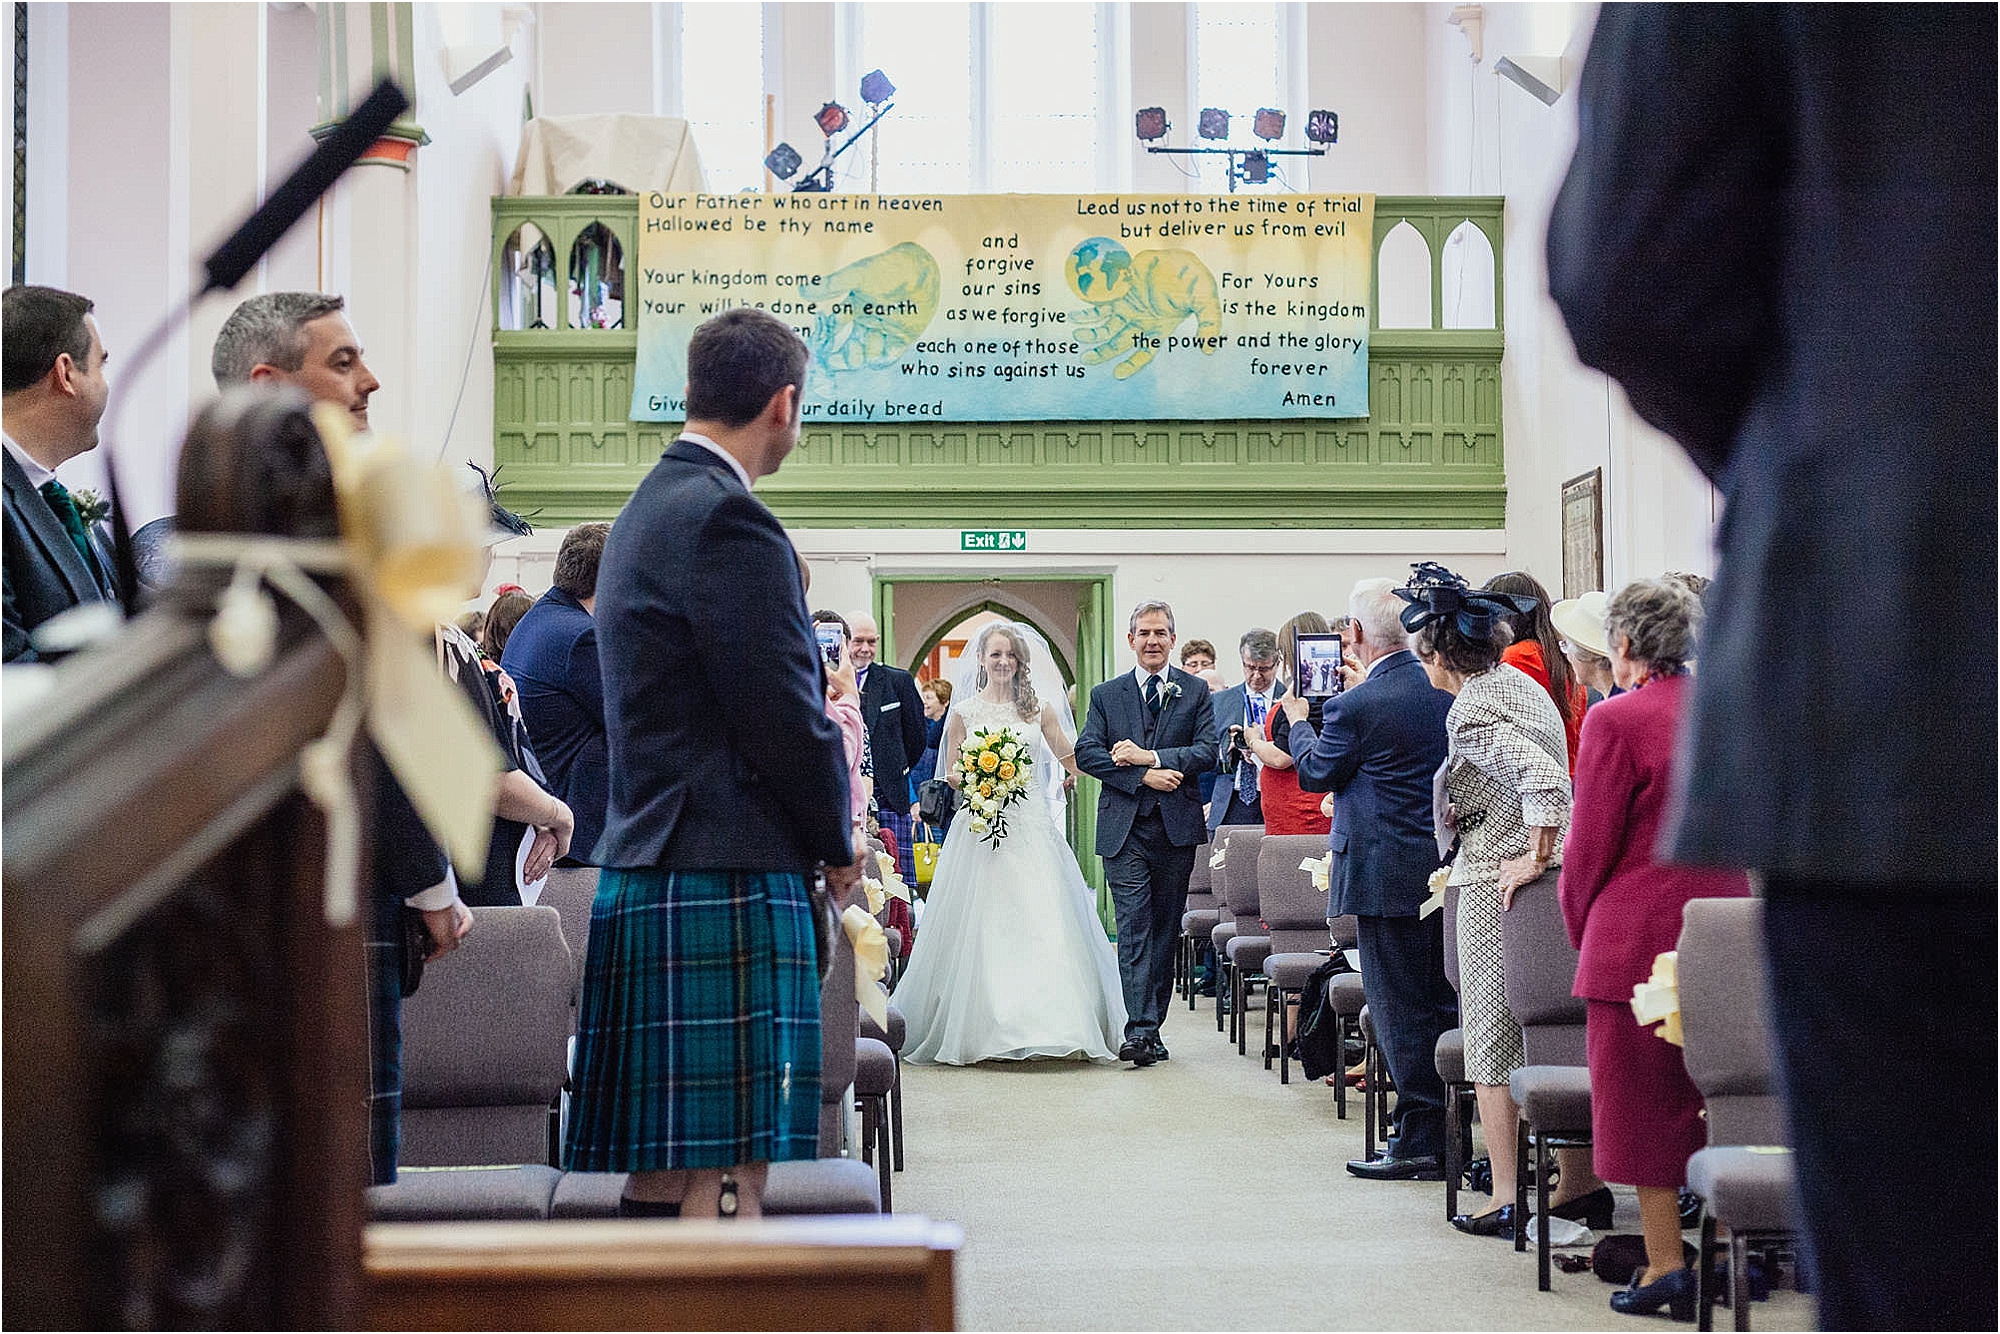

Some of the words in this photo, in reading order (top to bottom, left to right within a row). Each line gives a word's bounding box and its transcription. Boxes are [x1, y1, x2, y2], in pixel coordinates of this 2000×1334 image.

[649, 192, 687, 210] Our
[695, 193, 763, 210] Father
[773, 195, 811, 210] who
[817, 196, 849, 211] art
[854, 195, 870, 211] in
[877, 195, 943, 212] heaven
[1077, 197, 1120, 216] Lead
[1126, 203, 1147, 216] us
[1150, 199, 1180, 215] not
[1183, 199, 1203, 214] to
[1208, 197, 1240, 214] the
[1247, 197, 1288, 214] time
[1296, 200, 1316, 218] of
[1322, 196, 1361, 213] trial
[646, 215, 733, 234] Hallowed
[744, 214, 767, 232] be
[779, 217, 812, 236] thy
[824, 221, 874, 234] name
[1120, 222, 1153, 239] but
[1158, 219, 1226, 237] deliver
[1234, 223, 1255, 237] us
[1260, 218, 1307, 238] from
[1314, 220, 1345, 237] evil
[982, 232, 1018, 249] and
[965, 254, 1035, 276] forgive
[643, 268, 686, 285] Your
[691, 269, 768, 290] kingdom
[775, 274, 822, 288] come
[962, 284, 996, 297] our
[1004, 279, 1041, 296] sins
[1221, 272, 1253, 289] For
[1263, 273, 1319, 289] Yours
[644, 299, 686, 314] Your
[699, 297, 732, 314] will
[770, 299, 817, 315] done
[831, 303, 853, 315] on
[862, 299, 918, 316] earth
[1223, 302, 1239, 315] is
[1244, 300, 1277, 316] the
[1287, 300, 1365, 322] kingdom
[946, 308, 968, 321] as
[971, 309, 997, 321] we
[1001, 306, 1066, 329] forgive
[915, 337, 956, 354] each
[964, 341, 998, 354] one
[1002, 340, 1021, 358] of
[1024, 337, 1079, 355] those
[1131, 331, 1161, 349] the
[1168, 335, 1228, 353] power
[1236, 332, 1271, 349] and
[1277, 331, 1309, 348] the
[1314, 332, 1363, 355] glory
[901, 359, 940, 377] who
[947, 361, 987, 379] sins
[993, 360, 1059, 382] against
[1066, 364, 1086, 379] us
[1250, 357, 1328, 376] forever
[648, 394, 687, 412] Give
[1281, 390, 1336, 407] Amen
[801, 402, 822, 416] ur
[827, 399, 876, 419] daily
[884, 399, 943, 416] bread
[964, 533, 996, 548] Exit
